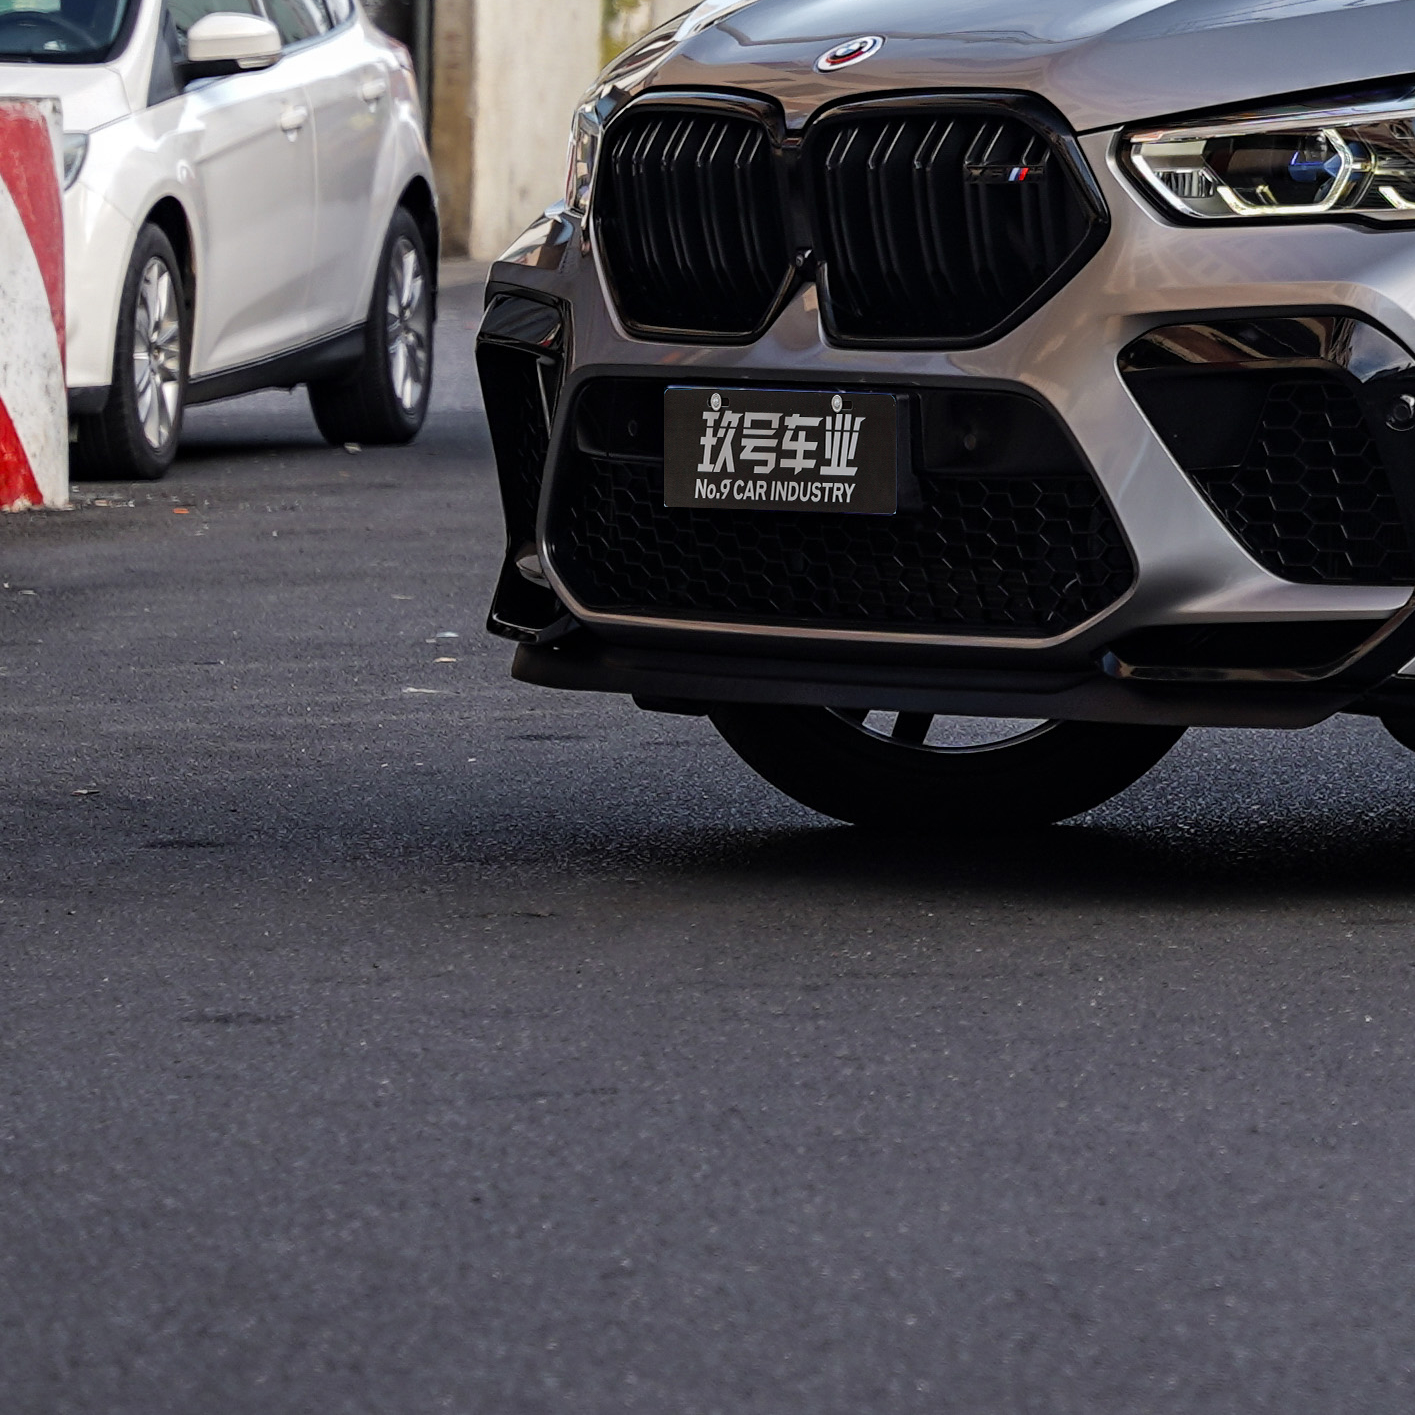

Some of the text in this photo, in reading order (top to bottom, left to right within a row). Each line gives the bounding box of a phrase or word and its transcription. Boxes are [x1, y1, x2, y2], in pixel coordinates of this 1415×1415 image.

[697, 410, 866, 476] 玖号车业
[694, 478, 857, 503] No.9 CAR INDUSTRY
